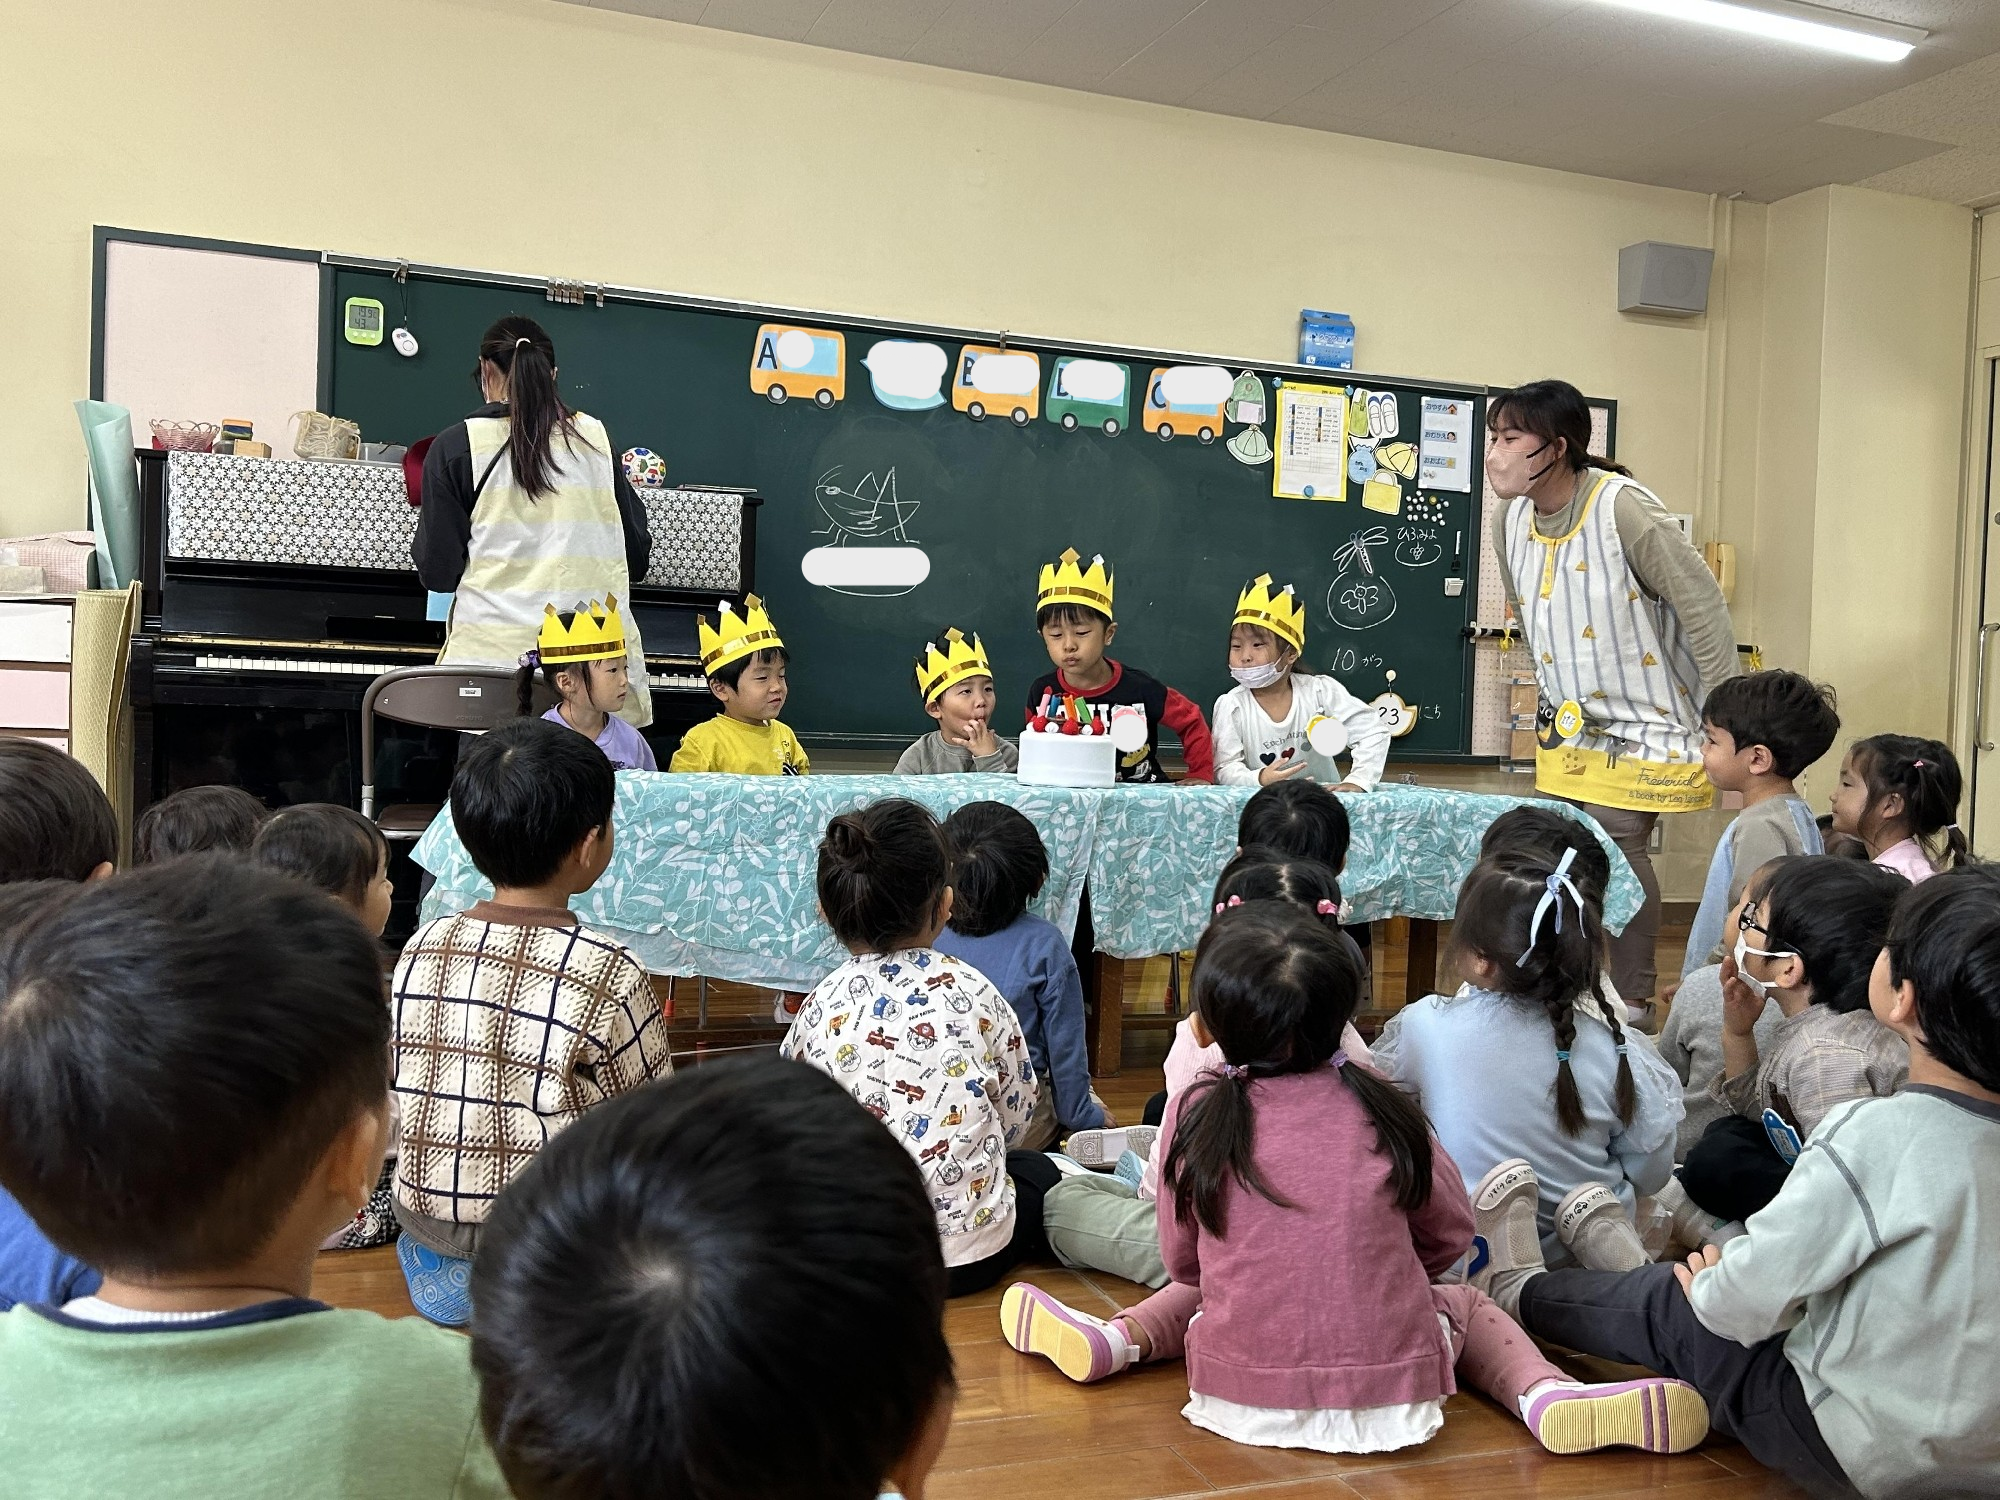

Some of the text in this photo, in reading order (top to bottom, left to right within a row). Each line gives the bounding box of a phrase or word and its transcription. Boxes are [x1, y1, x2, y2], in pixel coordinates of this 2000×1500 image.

[756, 337, 778, 370] A
[1425, 403, 1447, 412] おやすみ
[1331, 648, 1355, 671] 10
